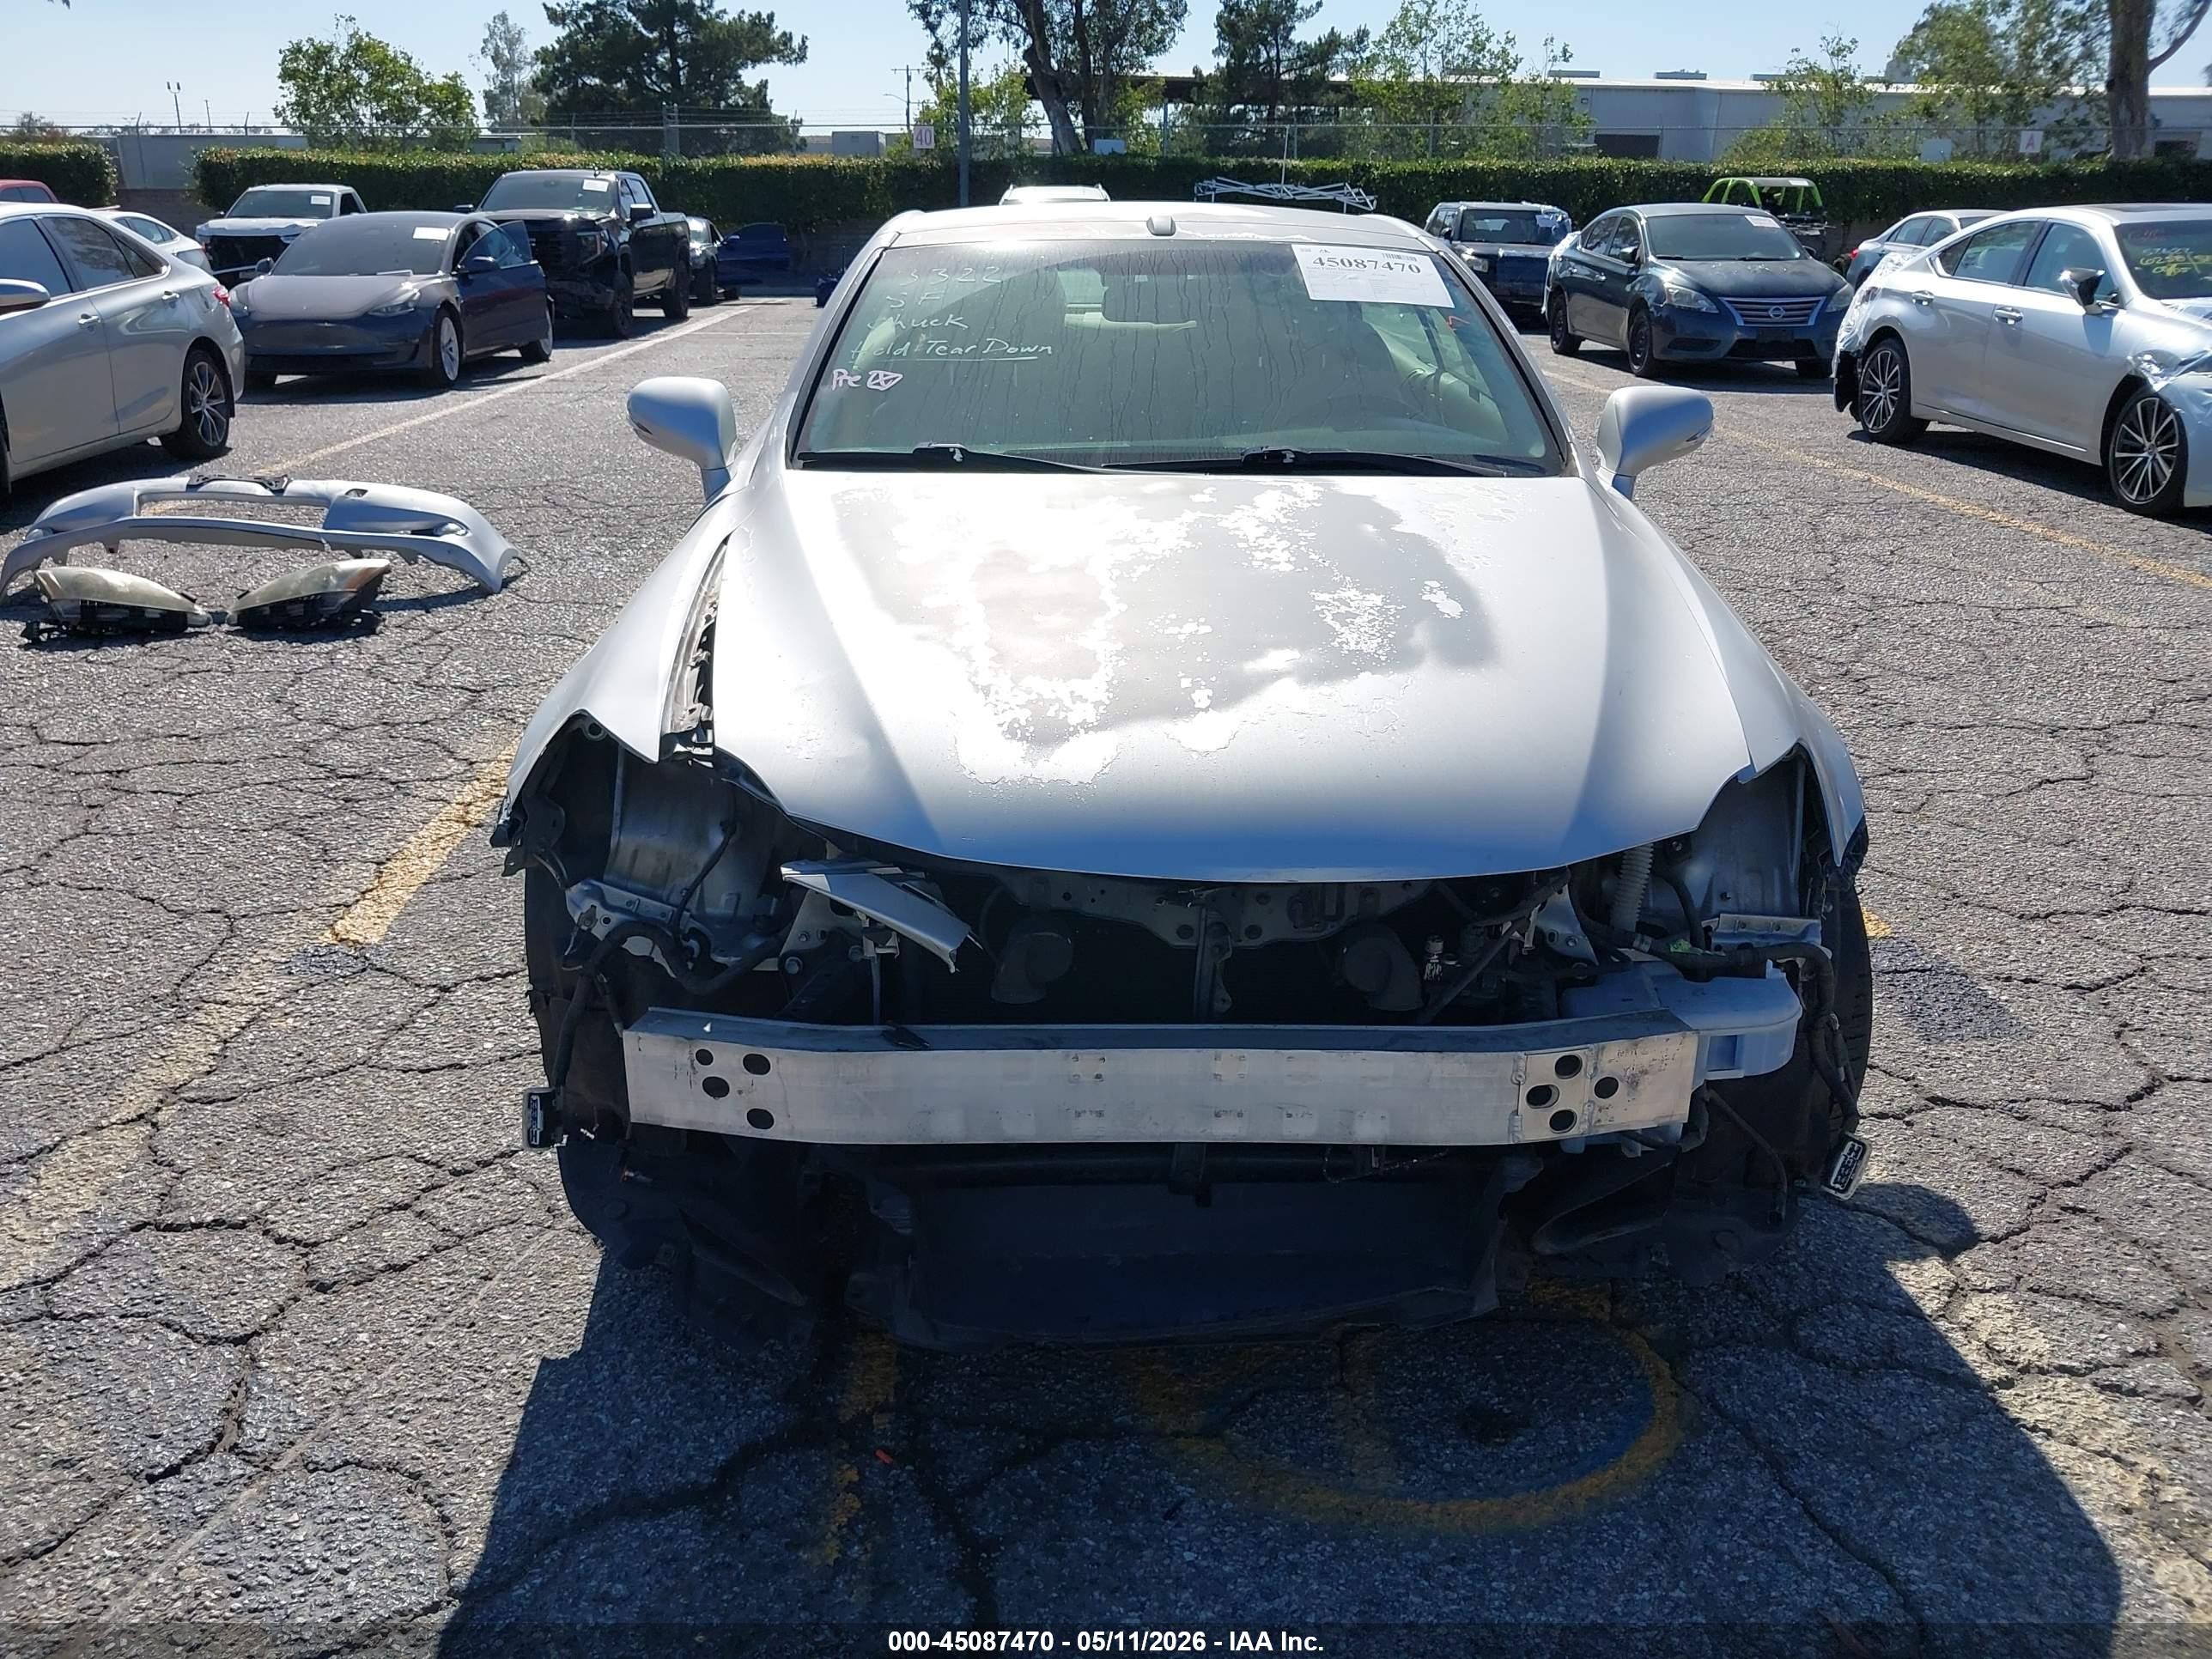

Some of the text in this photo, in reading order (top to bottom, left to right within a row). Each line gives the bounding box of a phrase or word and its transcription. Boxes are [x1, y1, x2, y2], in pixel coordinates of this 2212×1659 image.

[915, 129, 933, 145] 40
[1312, 256, 1421, 274] 45087470
[921, 340, 978, 356] Tear
[981, 338, 1053, 356] Down
